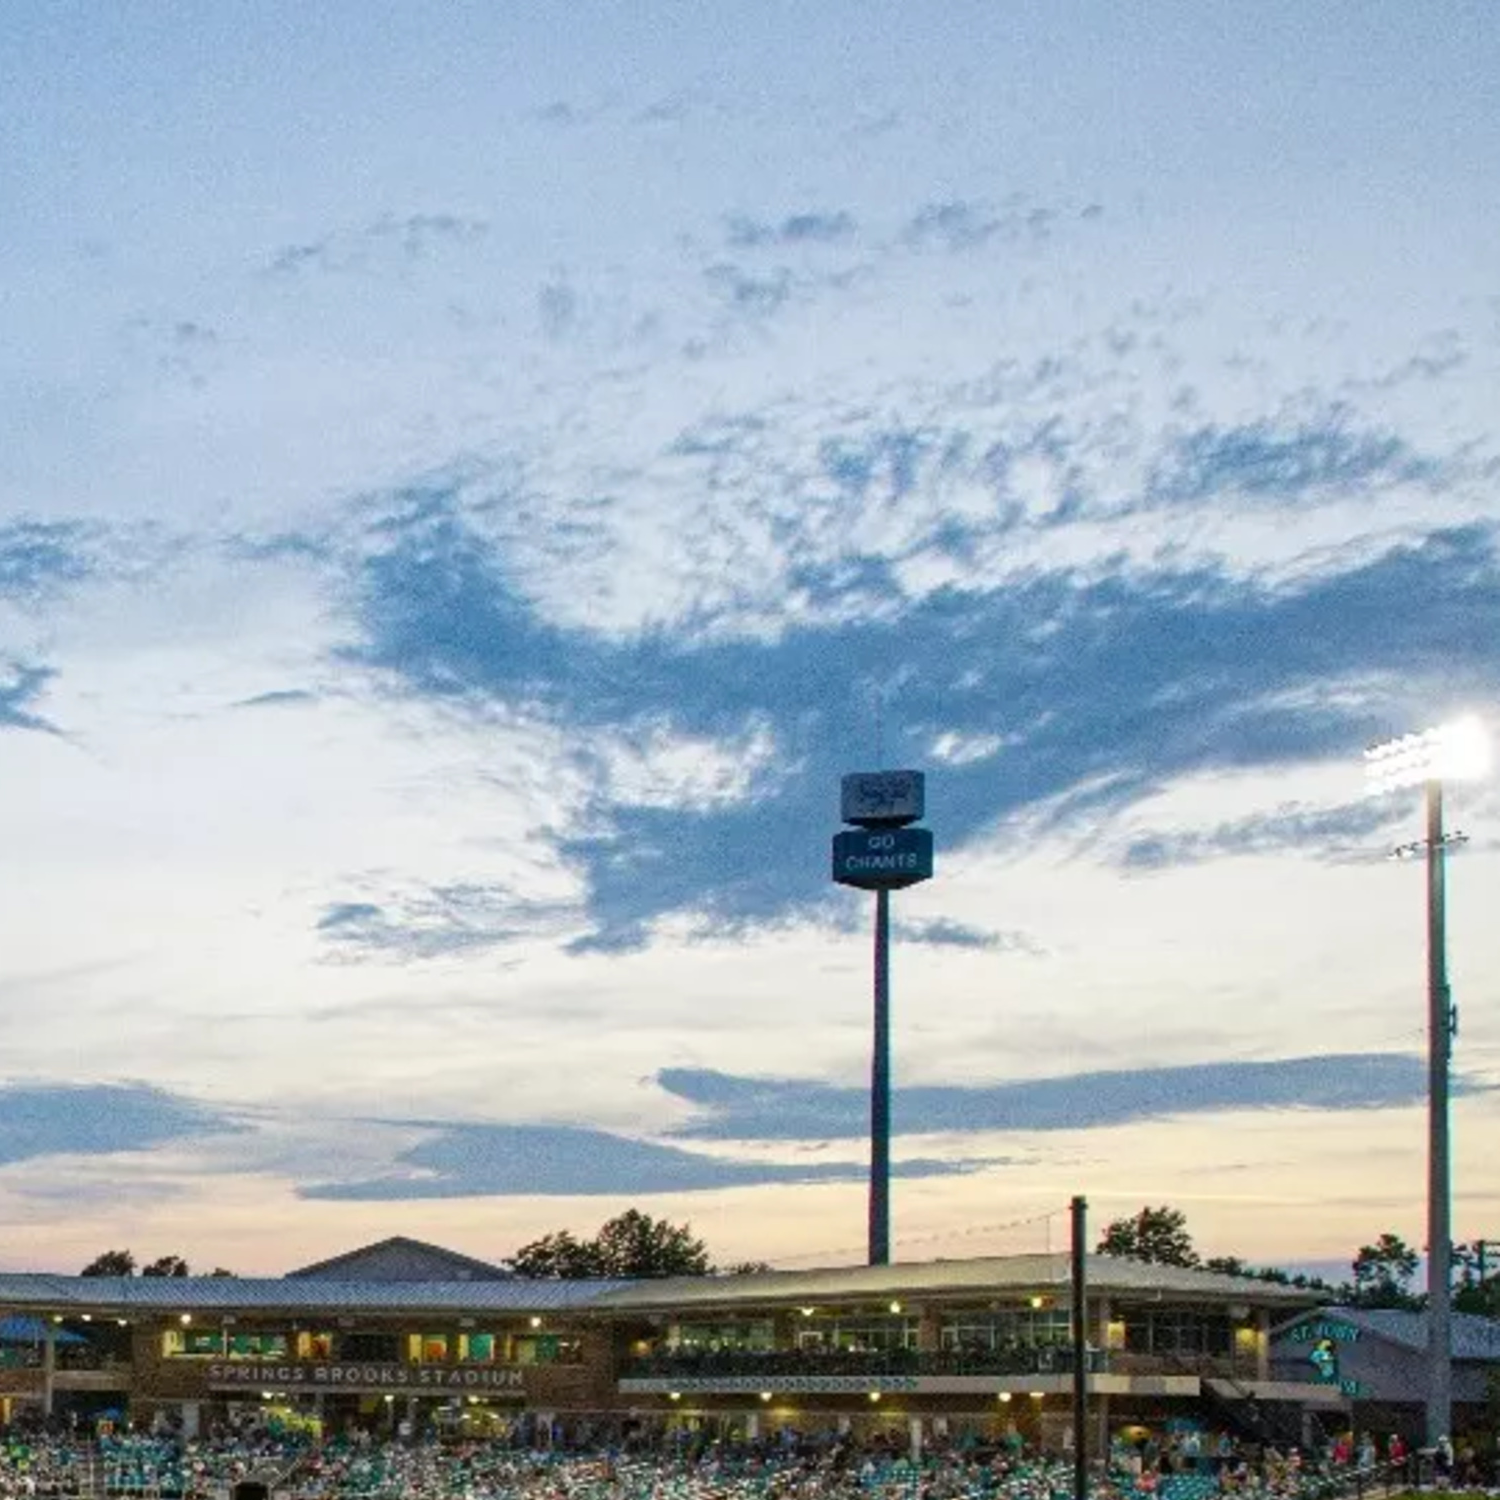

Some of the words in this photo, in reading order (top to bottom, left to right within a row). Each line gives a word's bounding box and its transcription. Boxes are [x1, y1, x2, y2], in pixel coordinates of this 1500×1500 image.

[868, 835, 896, 850] GO
[845, 853, 918, 870] CHANTS
[208, 1364, 304, 1382] SPRINGS
[314, 1366, 409, 1384] BROOKS
[419, 1369, 524, 1386] STADIUM
